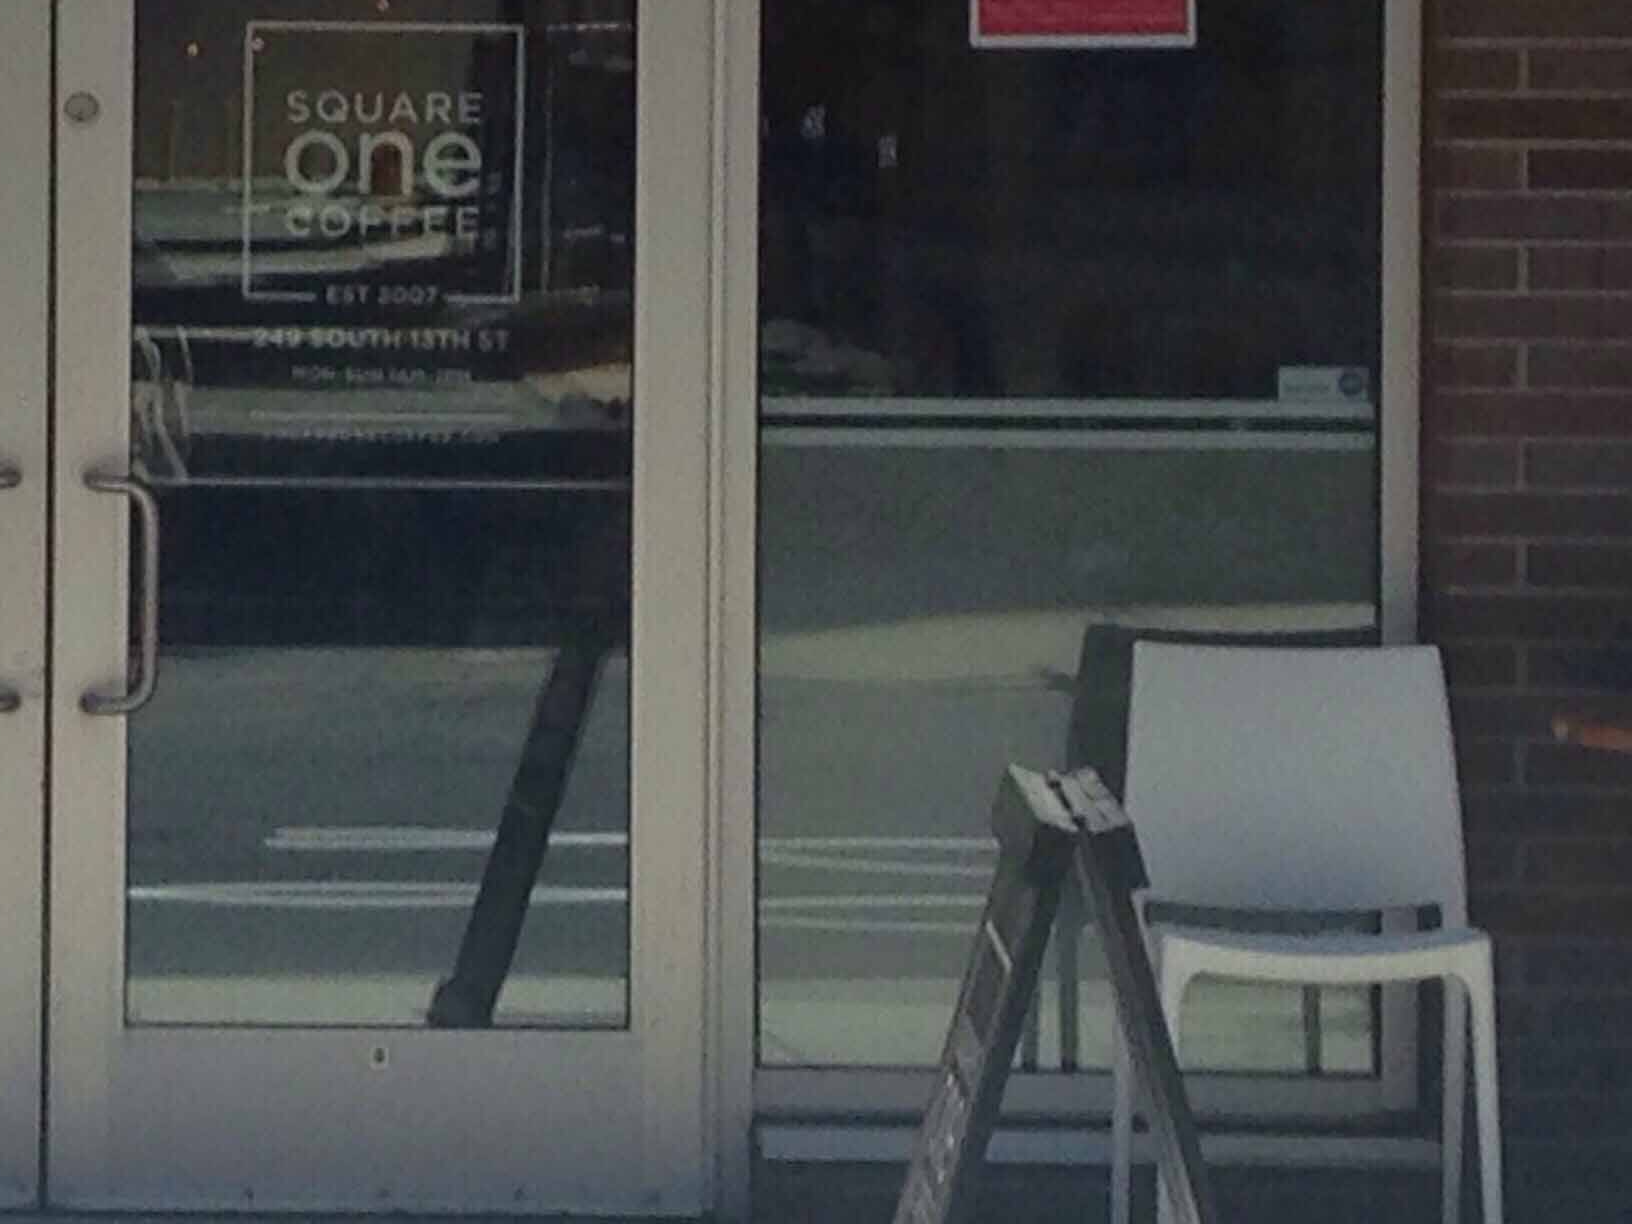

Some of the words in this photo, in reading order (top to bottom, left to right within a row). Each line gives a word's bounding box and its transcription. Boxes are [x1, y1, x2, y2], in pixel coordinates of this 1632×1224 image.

[285, 89, 485, 124] SQUARE
[284, 129, 483, 198] one
[284, 205, 480, 239] COFFEE
[325, 285, 369, 304] EST
[252, 328, 302, 350] 249
[311, 328, 401, 350] SOUTH
[411, 328, 471, 351] 13TH
[477, 329, 511, 352] ST
